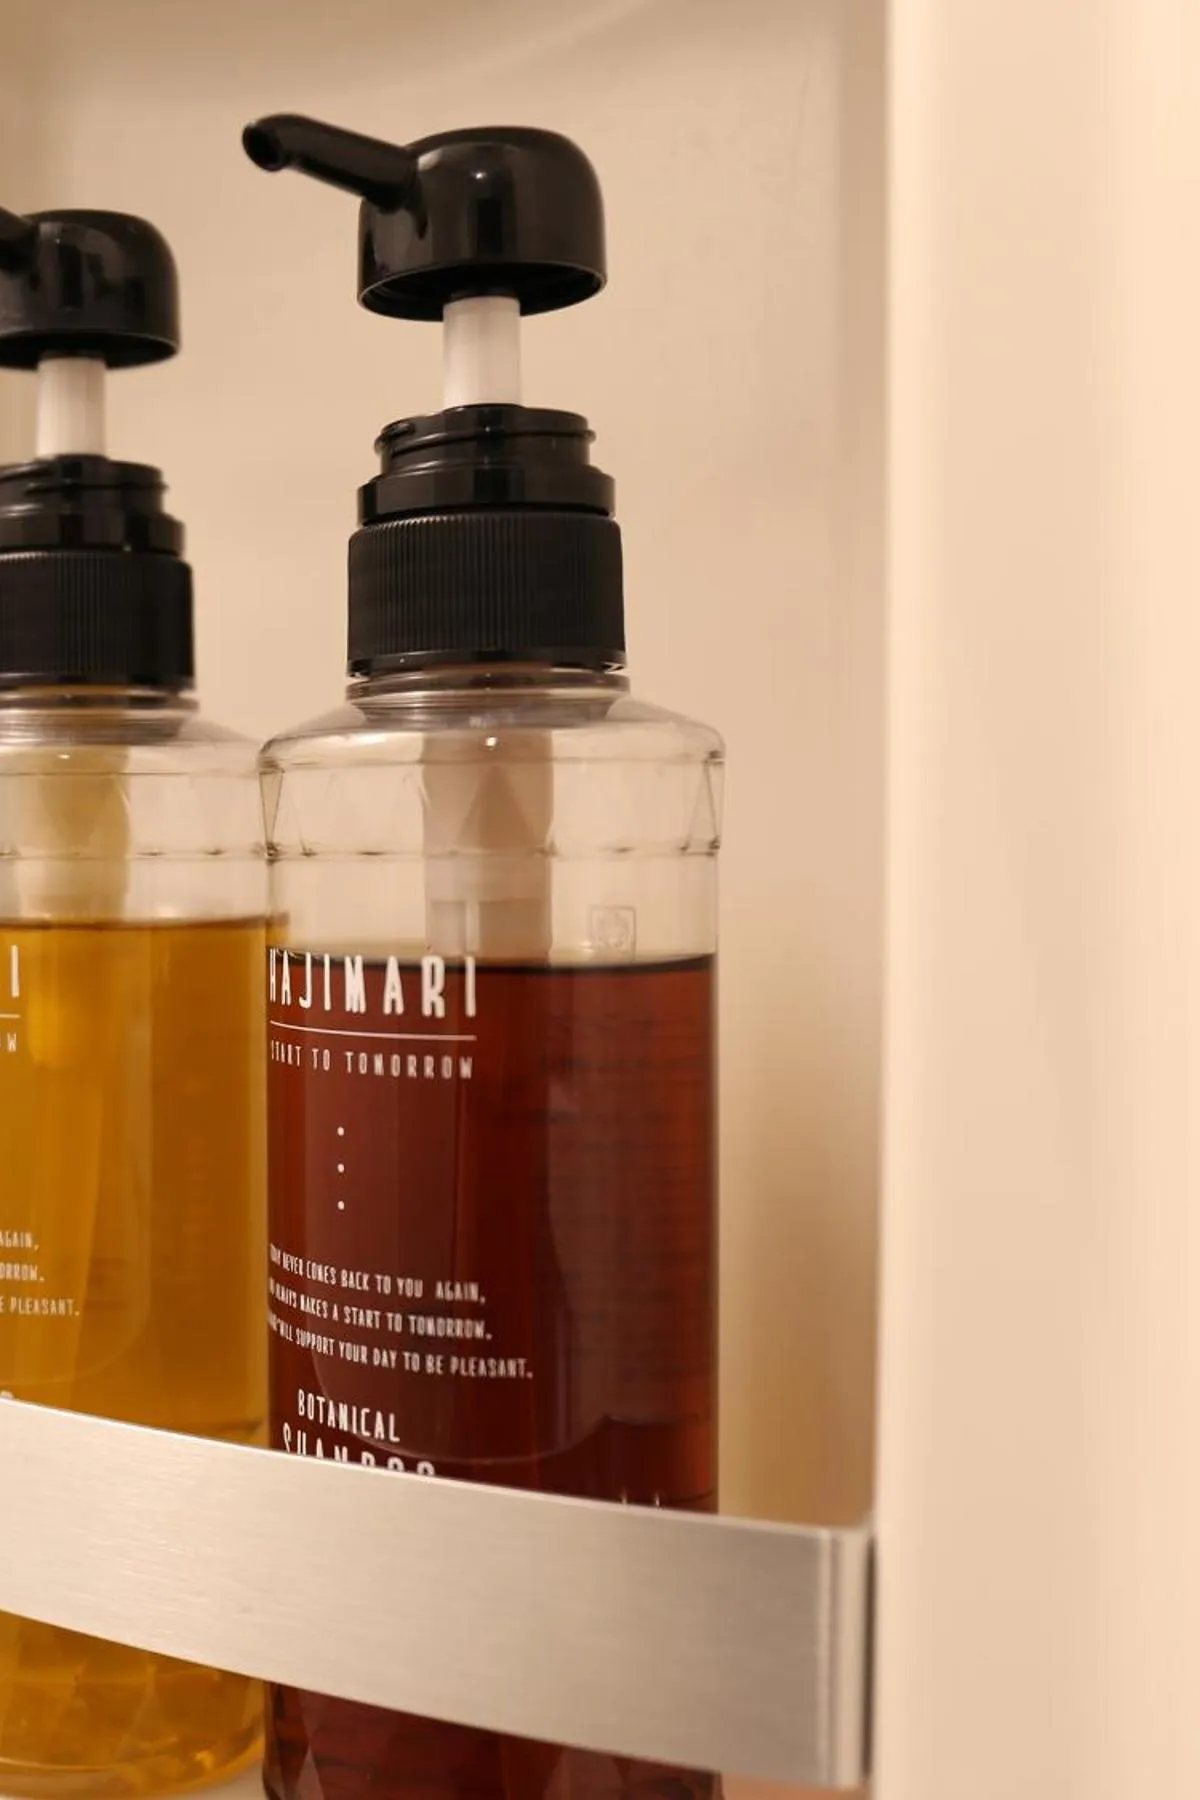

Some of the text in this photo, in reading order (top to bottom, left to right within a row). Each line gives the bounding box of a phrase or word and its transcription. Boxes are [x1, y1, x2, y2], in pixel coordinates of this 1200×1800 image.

[269, 947, 477, 1018] HAJIMARI
[311, 1048, 331, 1071] TO
[345, 1051, 473, 1079] TOMORROW
[307, 1260, 336, 1286] COMES
[341, 1268, 370, 1292] BACK
[376, 1274, 392, 1296] TO
[398, 1277, 424, 1299] YOU
[300, 1293, 328, 1319] MAKES
[332, 1303, 339, 1321] A
[343, 1305, 380, 1330] START
[386, 1311, 403, 1333] TO
[409, 1314, 493, 1341] TOMORROW.
[295, 1327, 335, 1356] SUPPORT
[339, 1340, 368, 1362] YOUR
[373, 1346, 398, 1370] DAY
[404, 1350, 420, 1372] TO
[425, 1354, 444, 1376] BE
[450, 1356, 534, 1380] PLEASANT.
[297, 1388, 401, 1443] BOTANICAL
